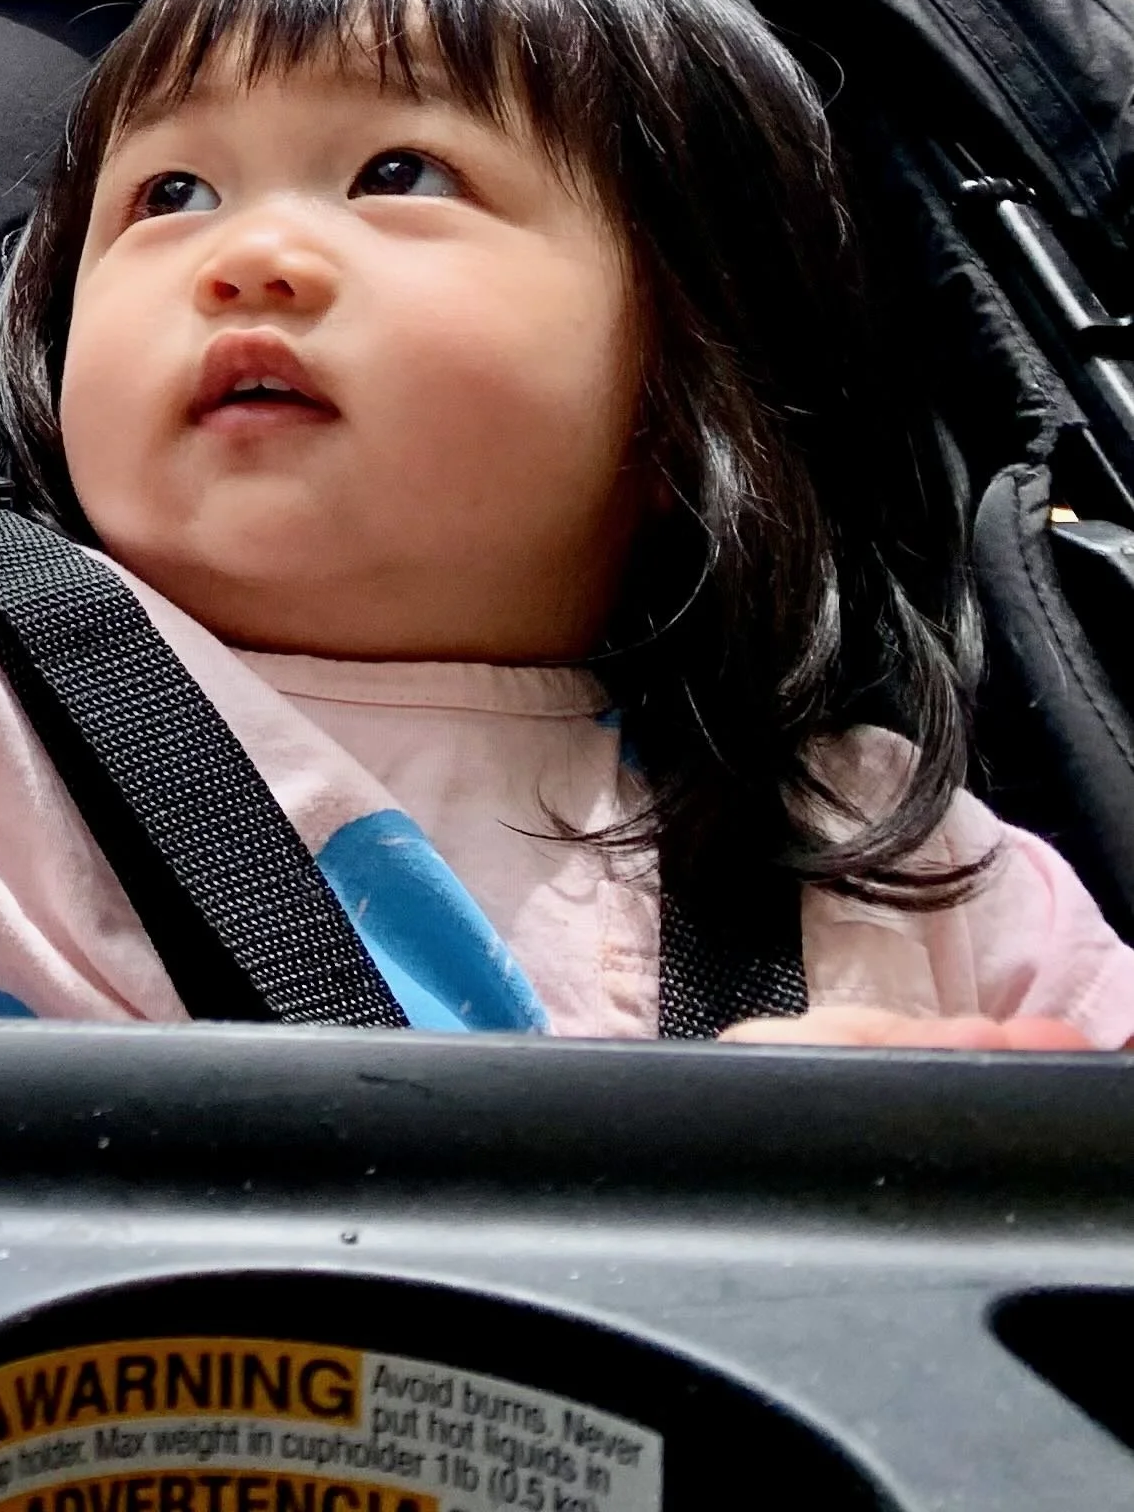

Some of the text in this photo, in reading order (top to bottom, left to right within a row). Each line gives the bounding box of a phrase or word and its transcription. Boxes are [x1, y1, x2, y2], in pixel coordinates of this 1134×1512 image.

[14, 1351, 354, 1431] WARNING
[372, 1363, 454, 1409] Avoid
[561, 1409, 643, 1468] Never
[93, 1426, 147, 1460] Max
[152, 1421, 240, 1463] weight
[246, 1422, 273, 1456] in
[280, 1431, 427, 1479] cupholder
[372, 1407, 612, 1494] put hot liquids in
